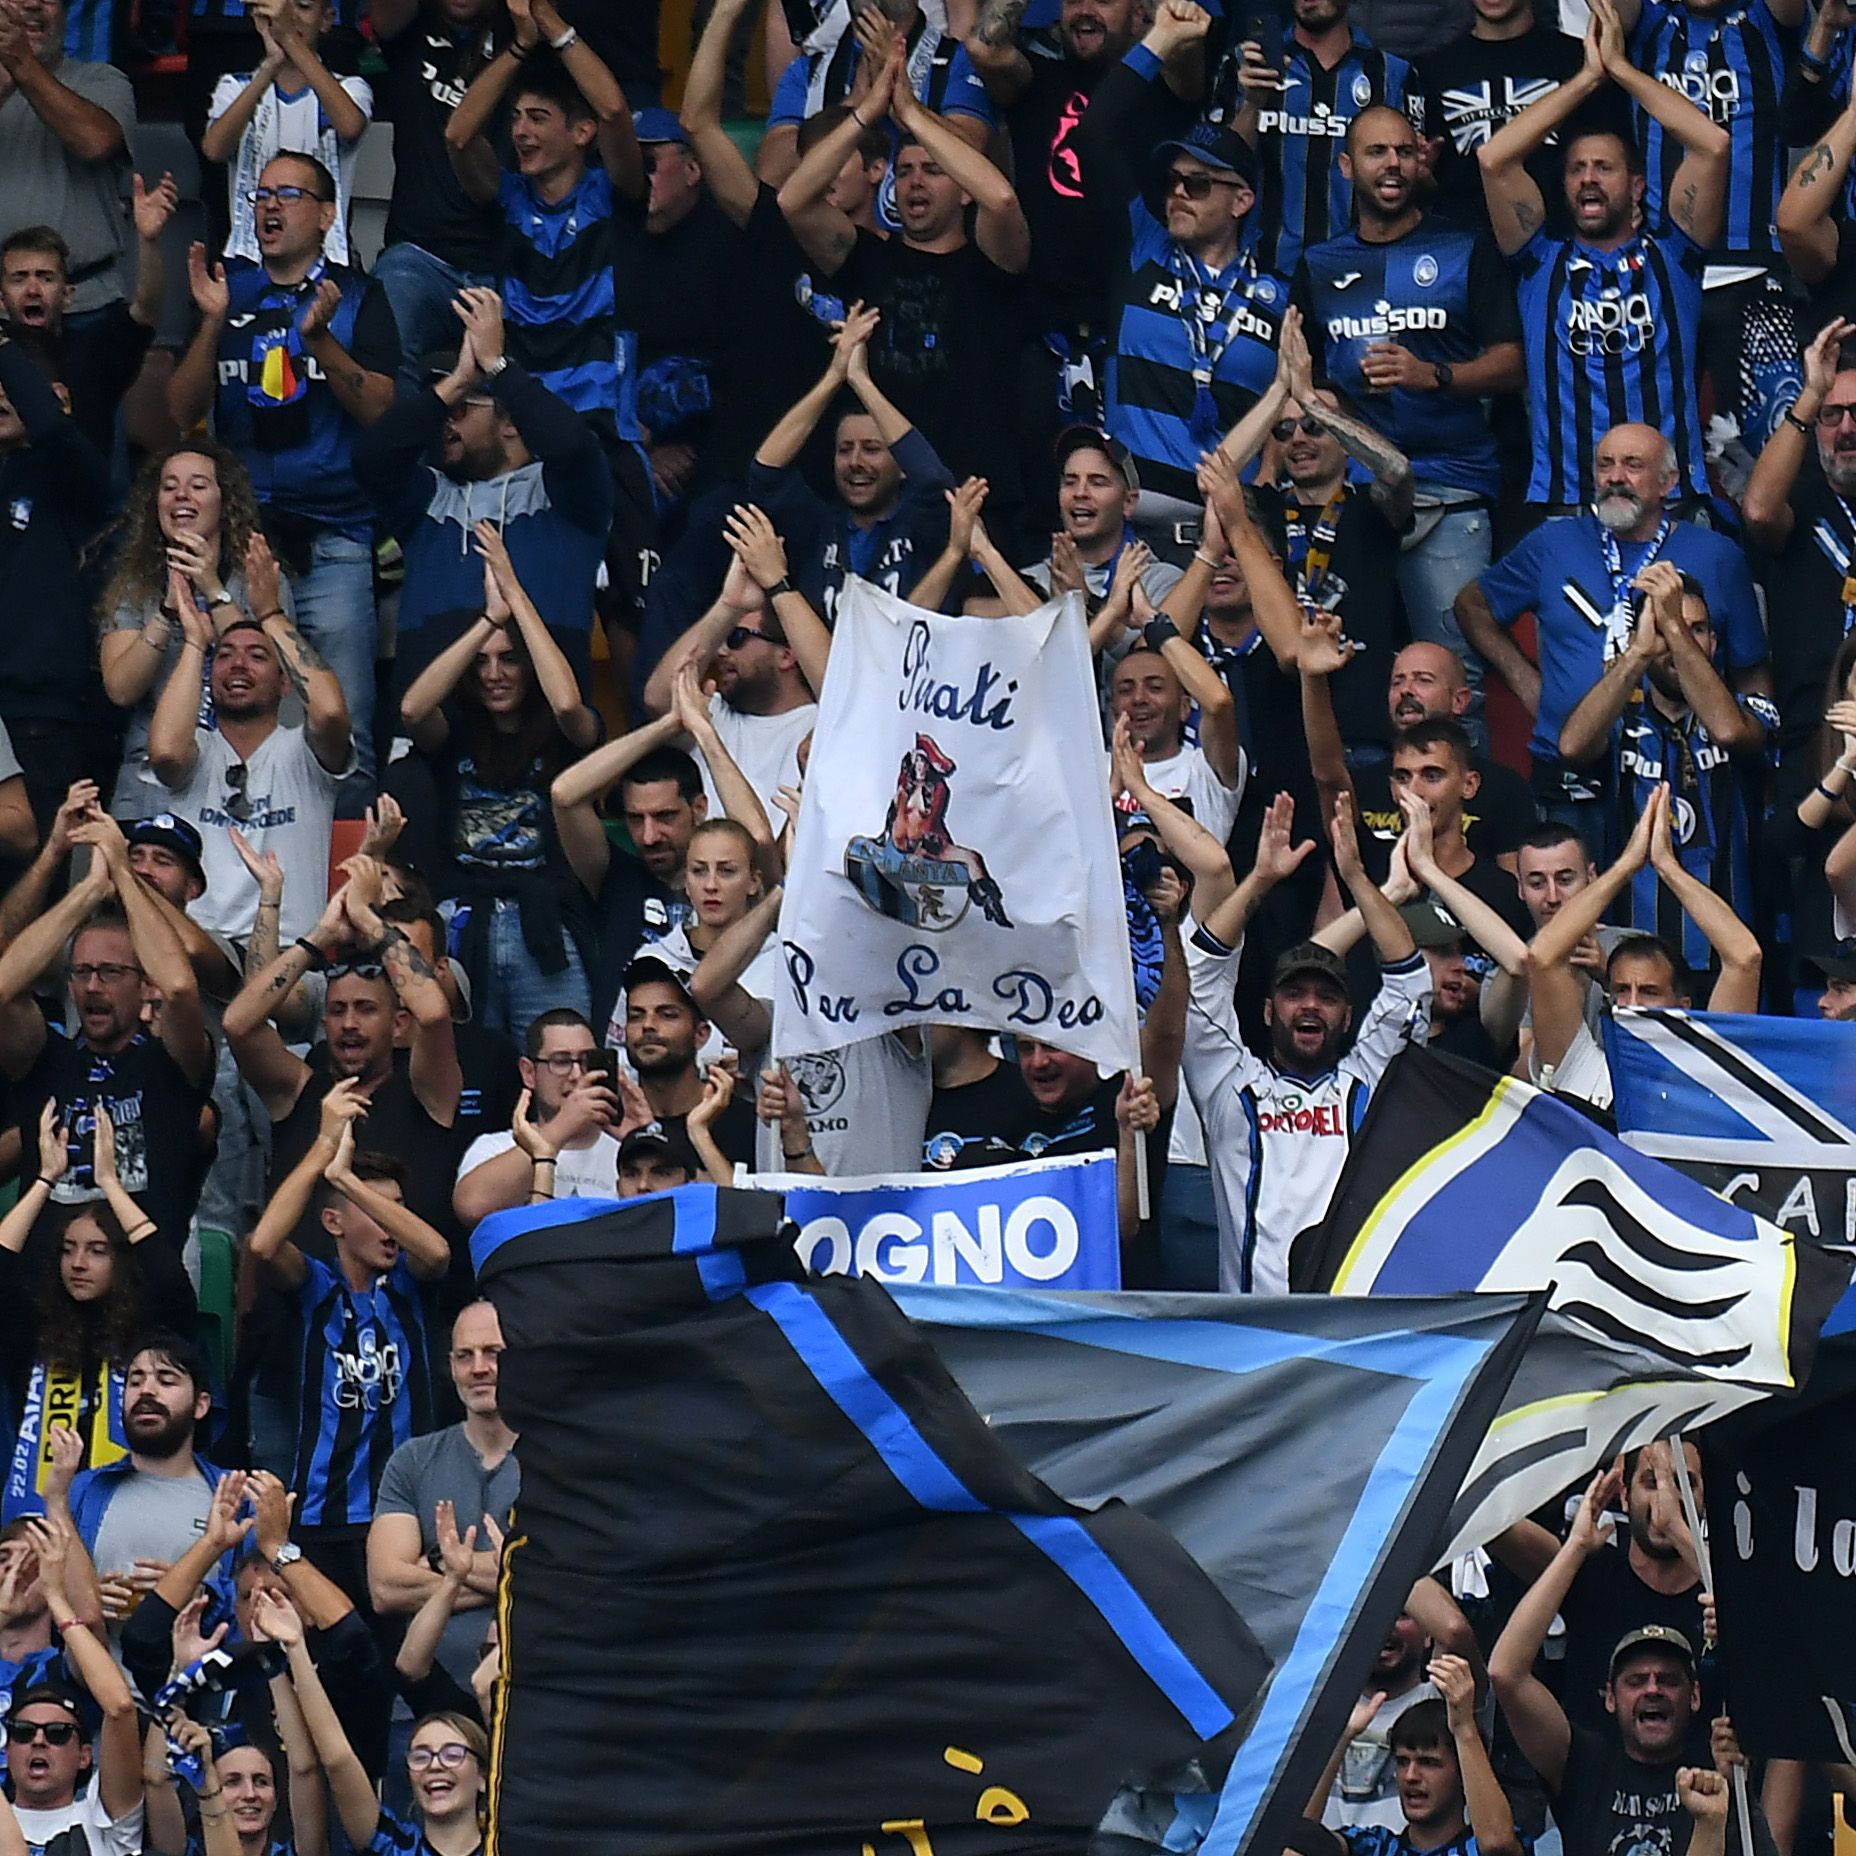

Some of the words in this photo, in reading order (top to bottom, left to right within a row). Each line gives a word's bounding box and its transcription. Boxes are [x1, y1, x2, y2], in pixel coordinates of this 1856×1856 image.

[1259, 108, 1352, 138] Plus5
[1327, 305, 1447, 343] Plus500
[1567, 323, 1656, 356] GROUP
[785, 939, 862, 1021] Per
[995, 970, 1105, 1030] Dea
[778, 1196, 1081, 1288] OGNO
